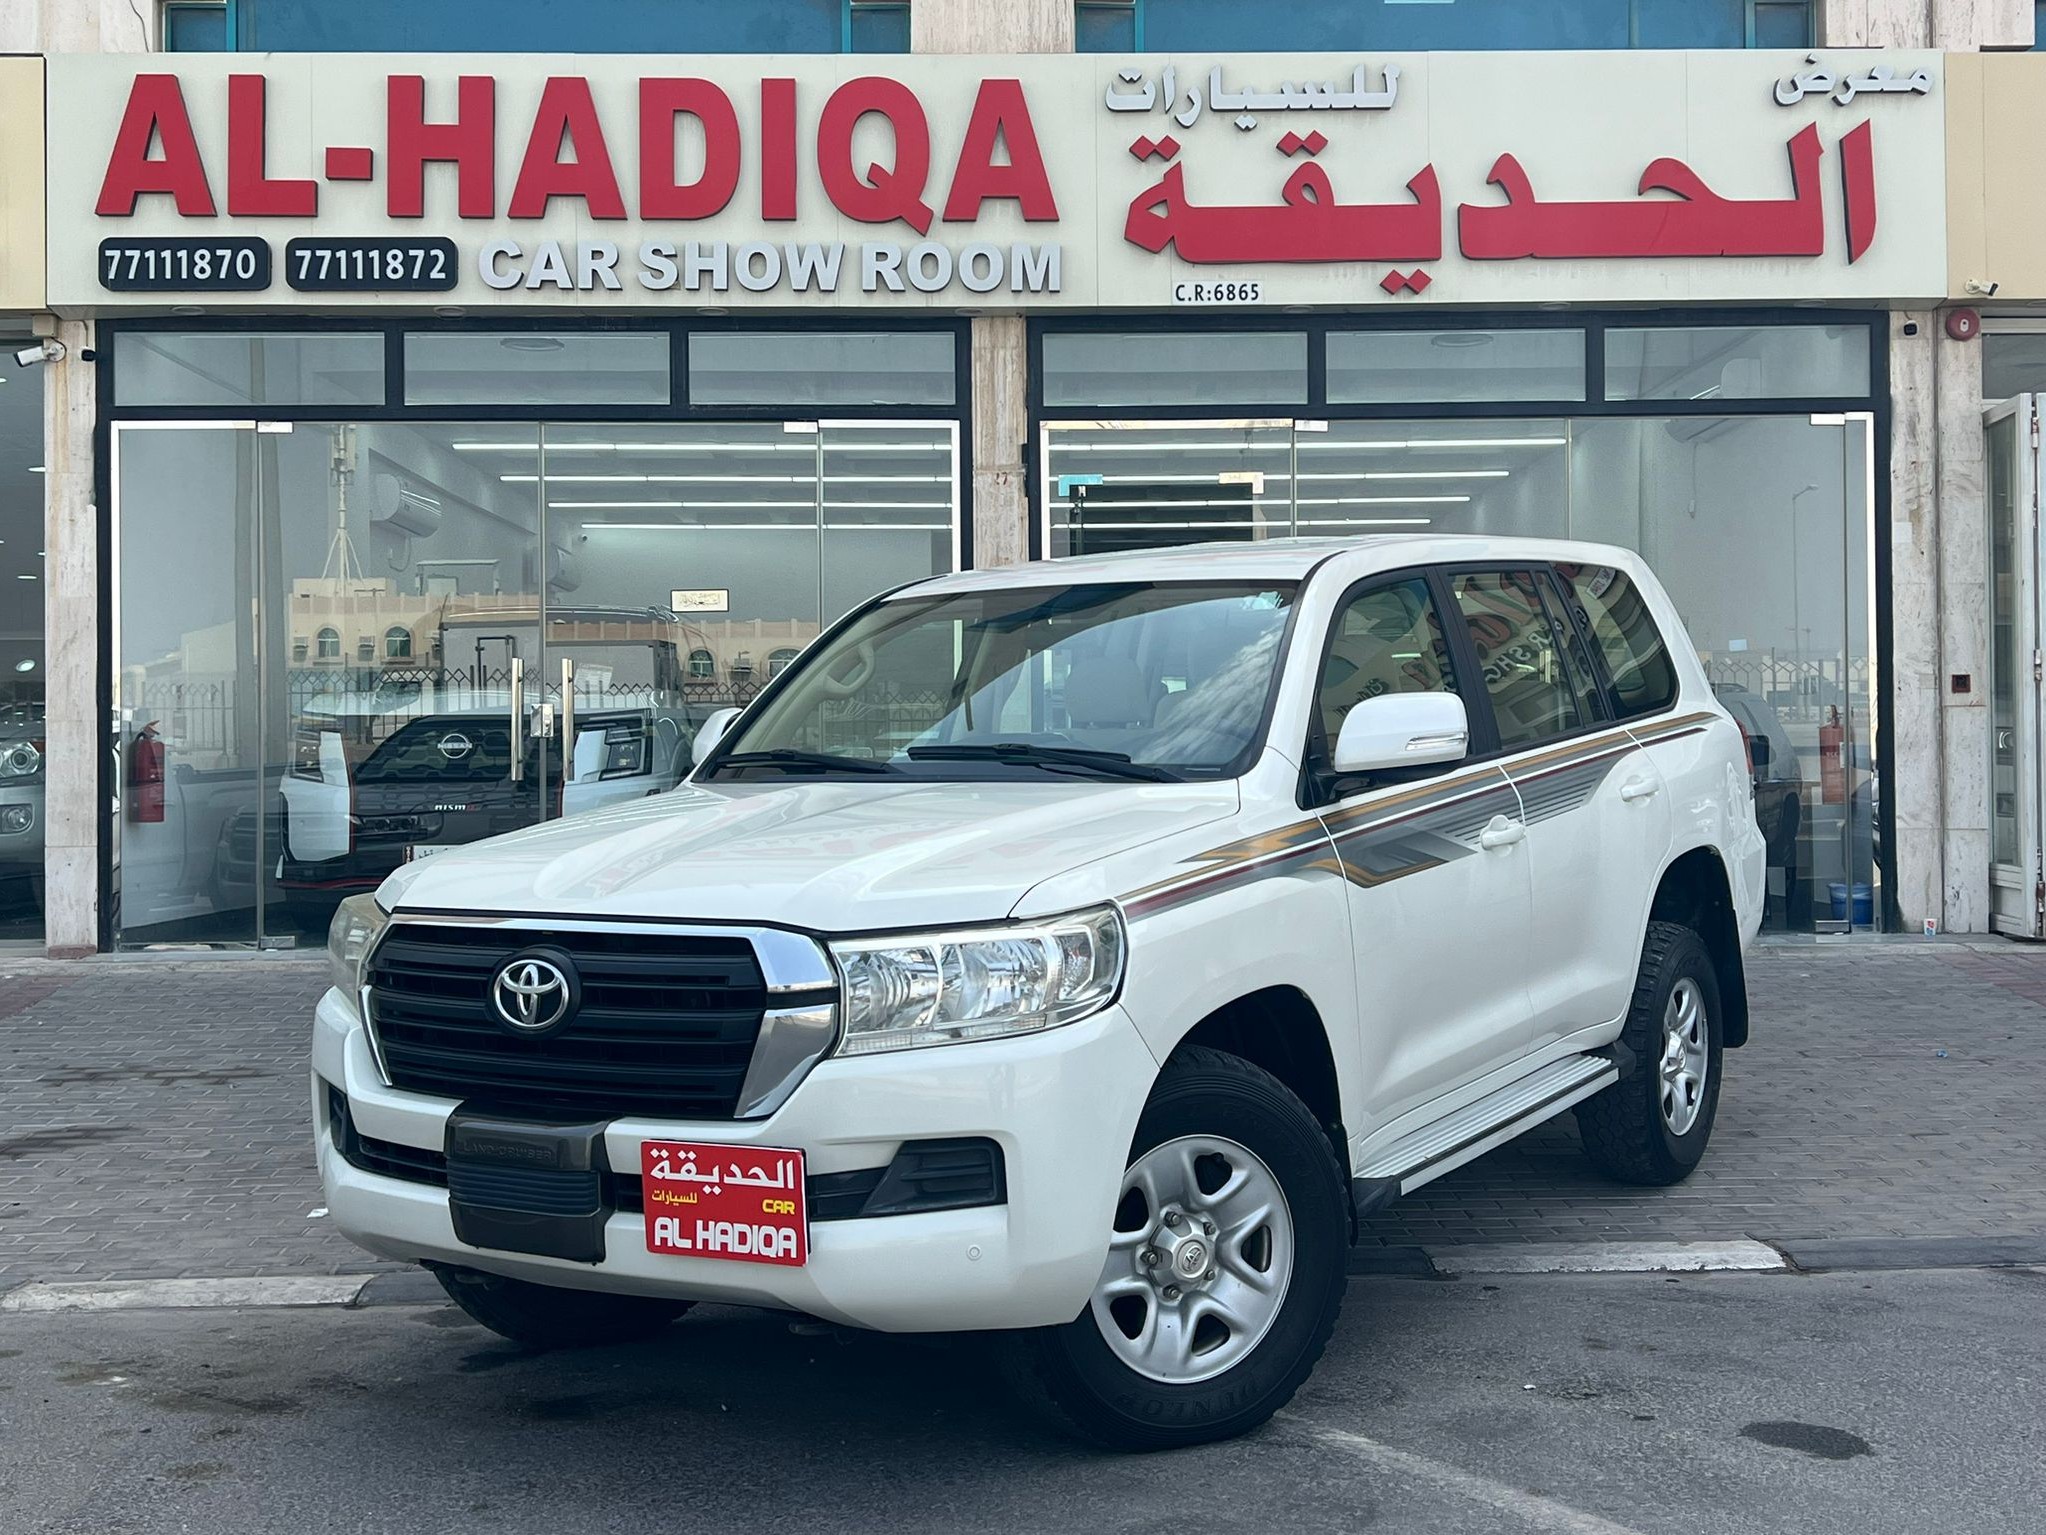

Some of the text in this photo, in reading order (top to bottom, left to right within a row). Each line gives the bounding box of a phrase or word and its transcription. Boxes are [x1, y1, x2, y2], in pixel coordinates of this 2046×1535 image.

[1104, 63, 1402, 132] للسيارات
[1773, 53, 1935, 108] معرض
[95, 73, 1060, 237] AL-HADIQA
[1123, 118, 1876, 295] الحديقة
[104, 248, 257, 280] 77111870
[294, 248, 447, 280] 77111872
[478, 239, 1062, 293] CAR SHOW ROOM
[1174, 282, 1260, 303] C.R:6865
[650, 1148, 795, 1196] الحديقة
[651, 1190, 698, 1207] للسيارات
[762, 1199, 795, 1215] CAR
[654, 1216, 798, 1259] AL HADIQA
